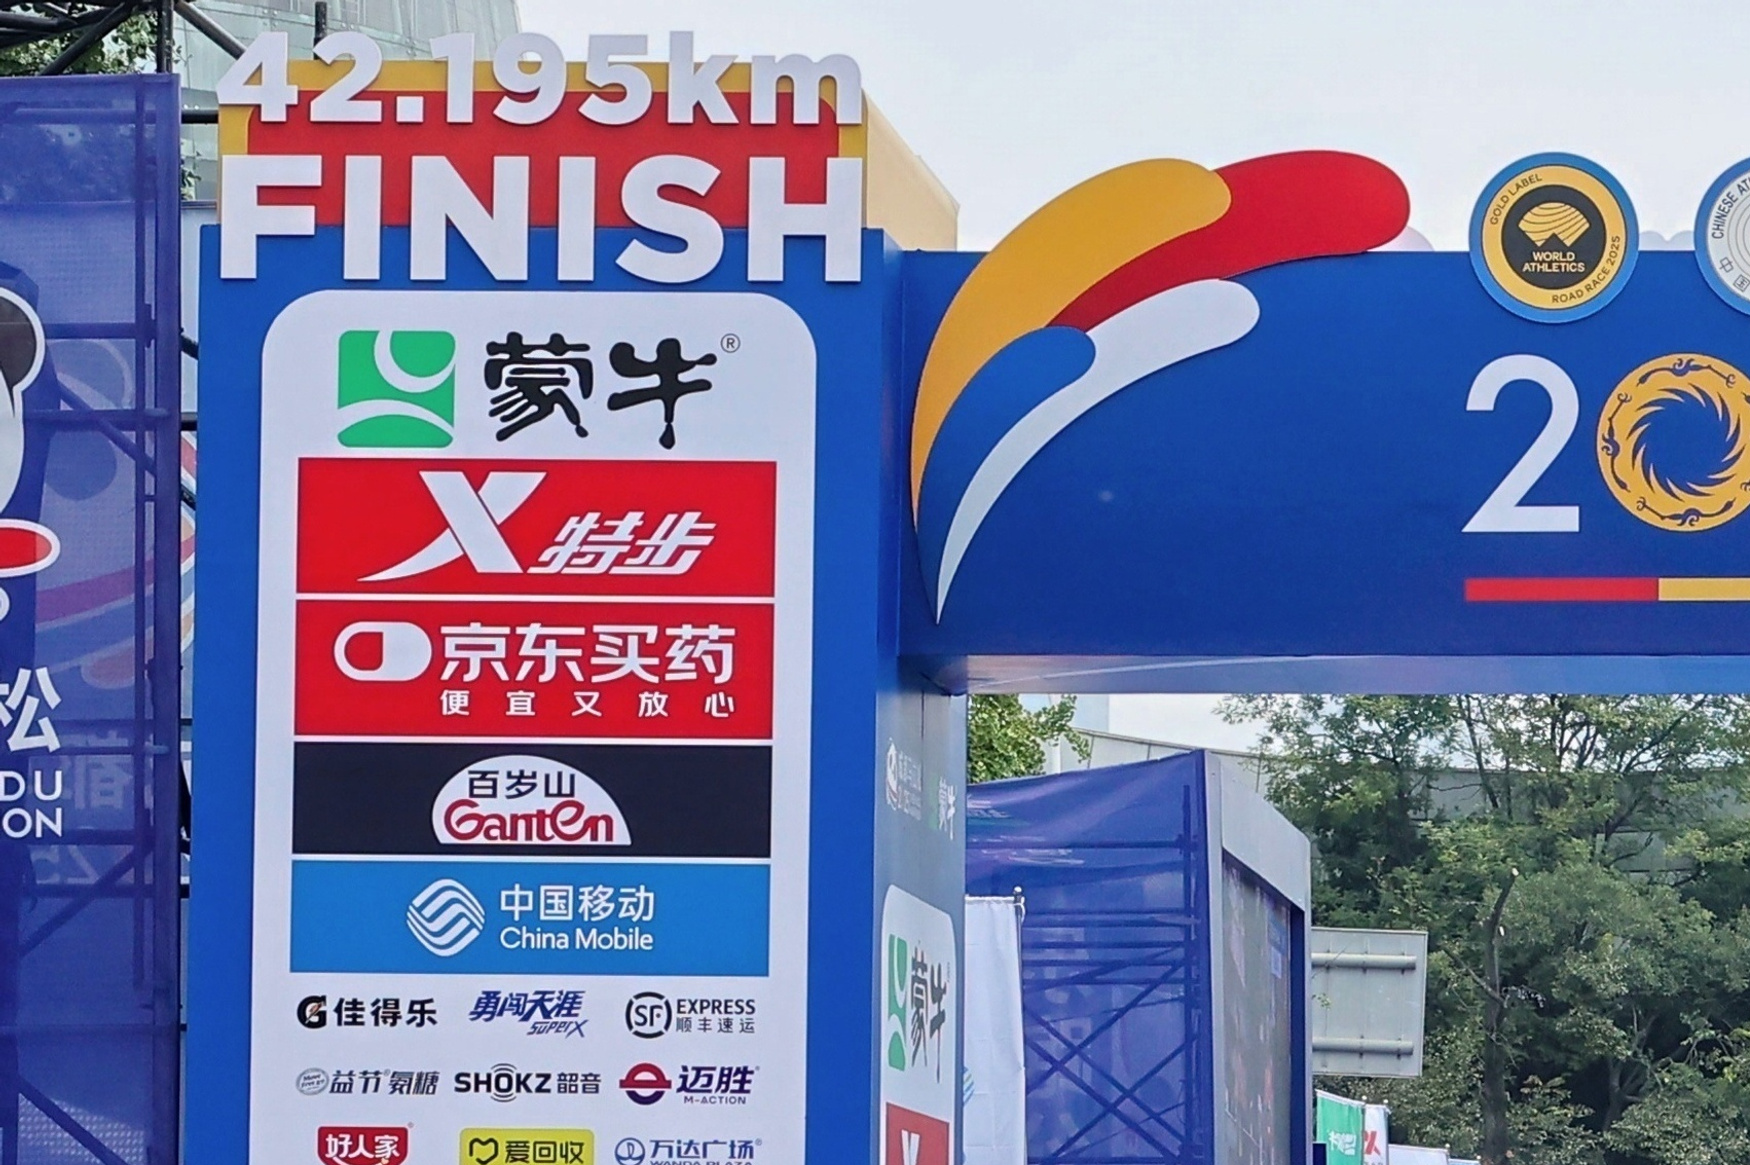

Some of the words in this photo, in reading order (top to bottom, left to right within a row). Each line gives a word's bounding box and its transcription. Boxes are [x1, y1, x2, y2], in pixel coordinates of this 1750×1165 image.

[216, 30, 863, 127] 42.195km
[1489, 197, 1511, 226] GOLD
[1508, 171, 1544, 199] LABEL
[219, 154, 864, 284] FINISH
[1711, 194, 1738, 240] CHINESE
[1522, 261, 1586, 274] ATHLETICS
[1532, 251, 1576, 262] WORLD
[1551, 287, 1585, 304] ROAD
[1585, 265, 1612, 294] RACE
[1608, 235, 1621, 264] 2025
[483, 331, 719, 450] 蒙牛
[525, 510, 718, 575] 特步
[440, 622, 737, 684] 京东买药
[439, 689, 736, 719] 便宜又放心
[467, 769, 578, 799] 百岁山
[499, 883, 656, 924] 中国移动
[500, 928, 570, 951] China
[574, 928, 654, 951] Mobile
[333, 997, 439, 1029] 佳得乐
[468, 989, 587, 1023] 勇闯天涯
[676, 998, 757, 1015] EXPRESS
[911, 944, 948, 1084] 蒙牛
[675, 1016, 757, 1034] 顺丰速运
[454, 1071, 553, 1094] SHOKZ
[556, 1071, 602, 1095] 韶音
[676, 1064, 755, 1095] 迈胜
[683, 1095, 747, 1106] M-ACTION
[324, 1133, 401, 1160] 好人家
[504, 1140, 585, 1165] 爱回收
[649, 1138, 755, 1160] 万达广场
